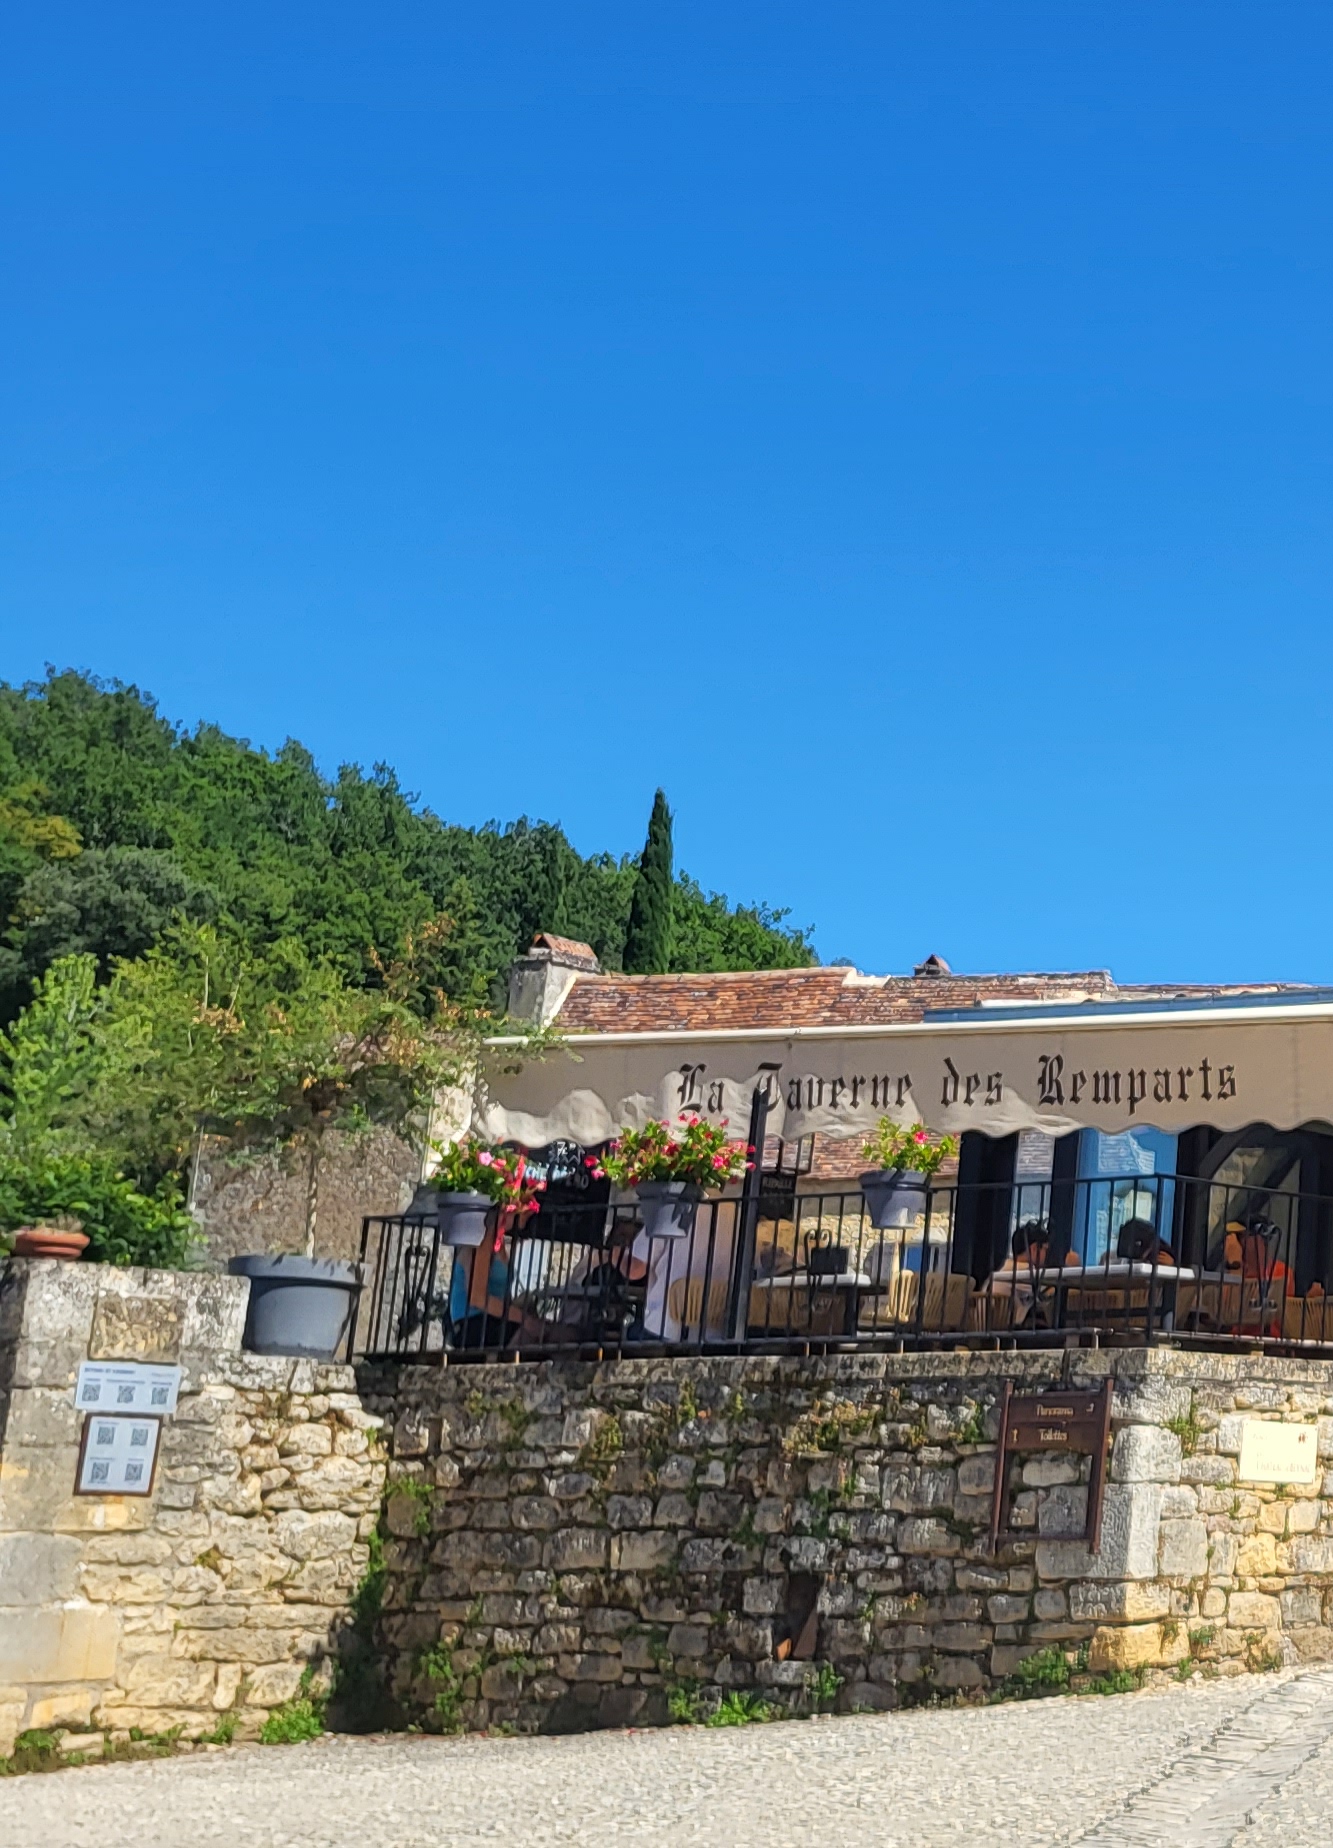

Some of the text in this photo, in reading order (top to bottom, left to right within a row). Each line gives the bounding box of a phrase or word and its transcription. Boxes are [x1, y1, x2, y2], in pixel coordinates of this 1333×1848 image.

[677, 1053, 1238, 1117] La Taverne des Remparts
[1038, 1427, 1068, 1441] Toilettes
